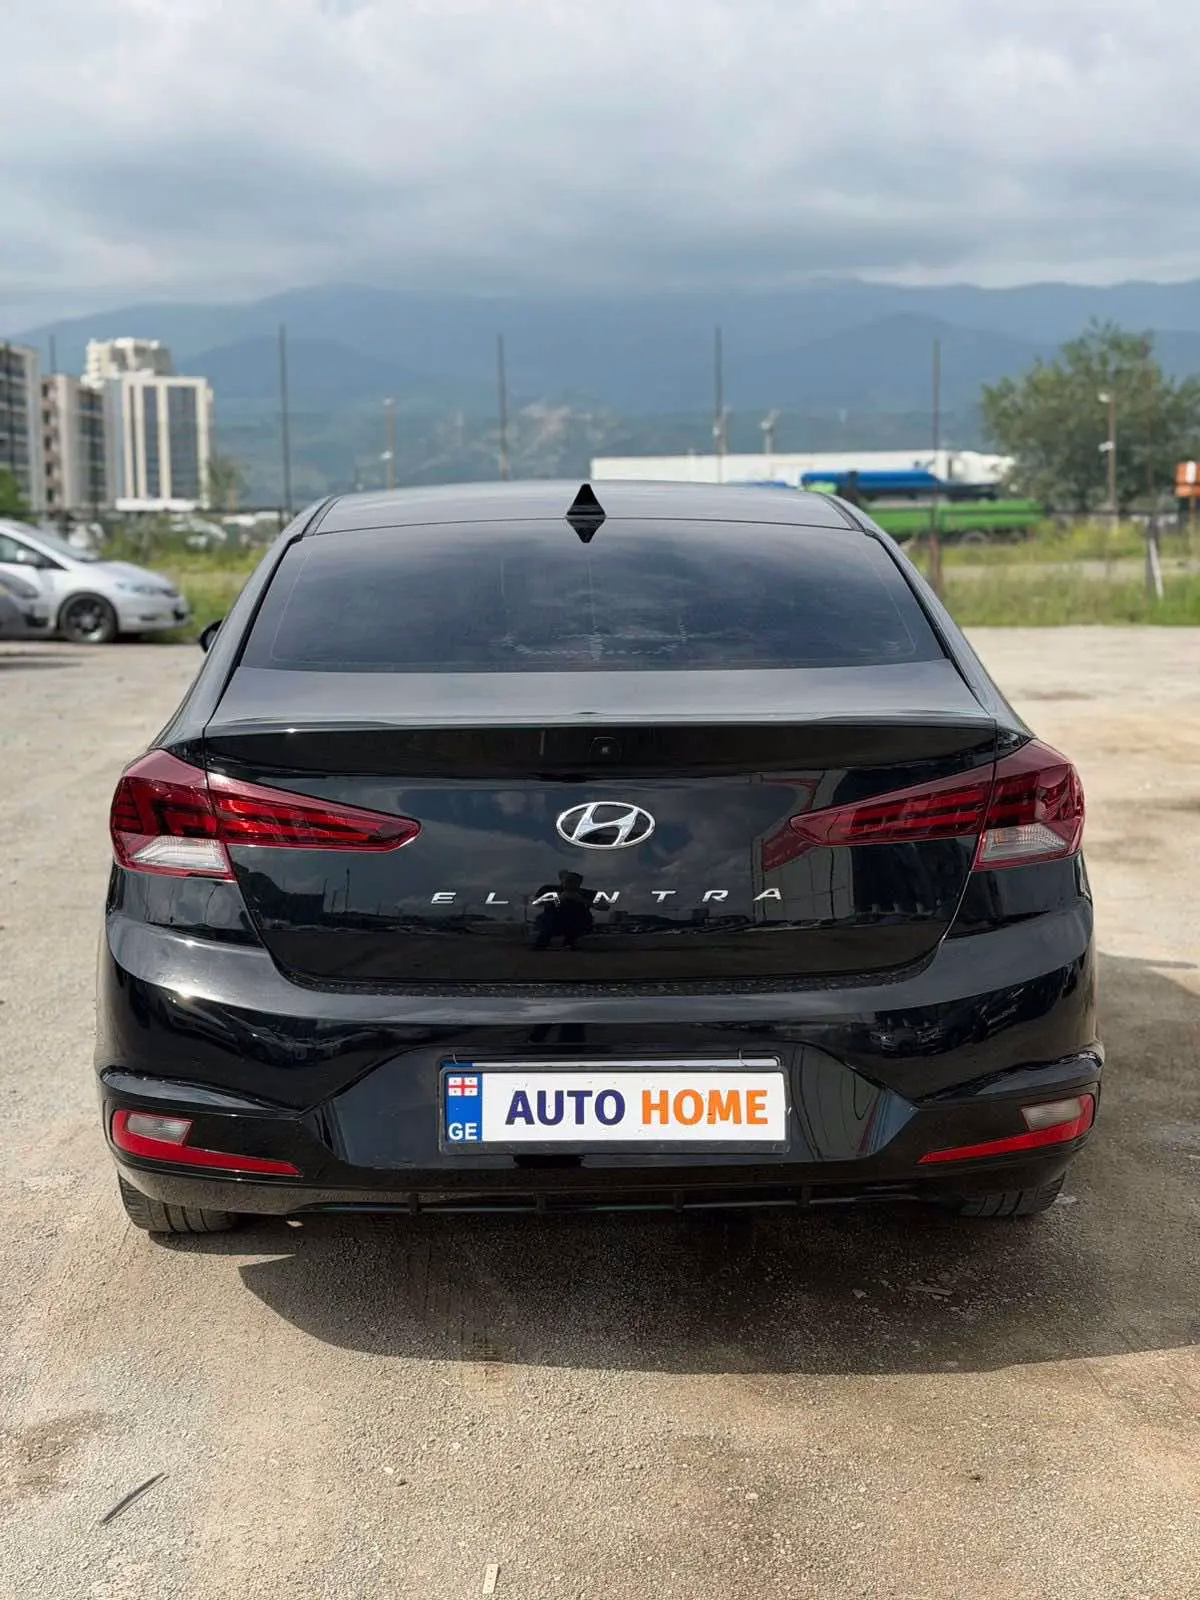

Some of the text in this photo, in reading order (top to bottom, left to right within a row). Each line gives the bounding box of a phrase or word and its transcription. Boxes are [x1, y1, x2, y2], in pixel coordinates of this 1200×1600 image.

[431, 888, 783, 905] ELANTRA
[505, 1089, 768, 1126] AUTO HOME
[448, 1122, 478, 1140] GE
